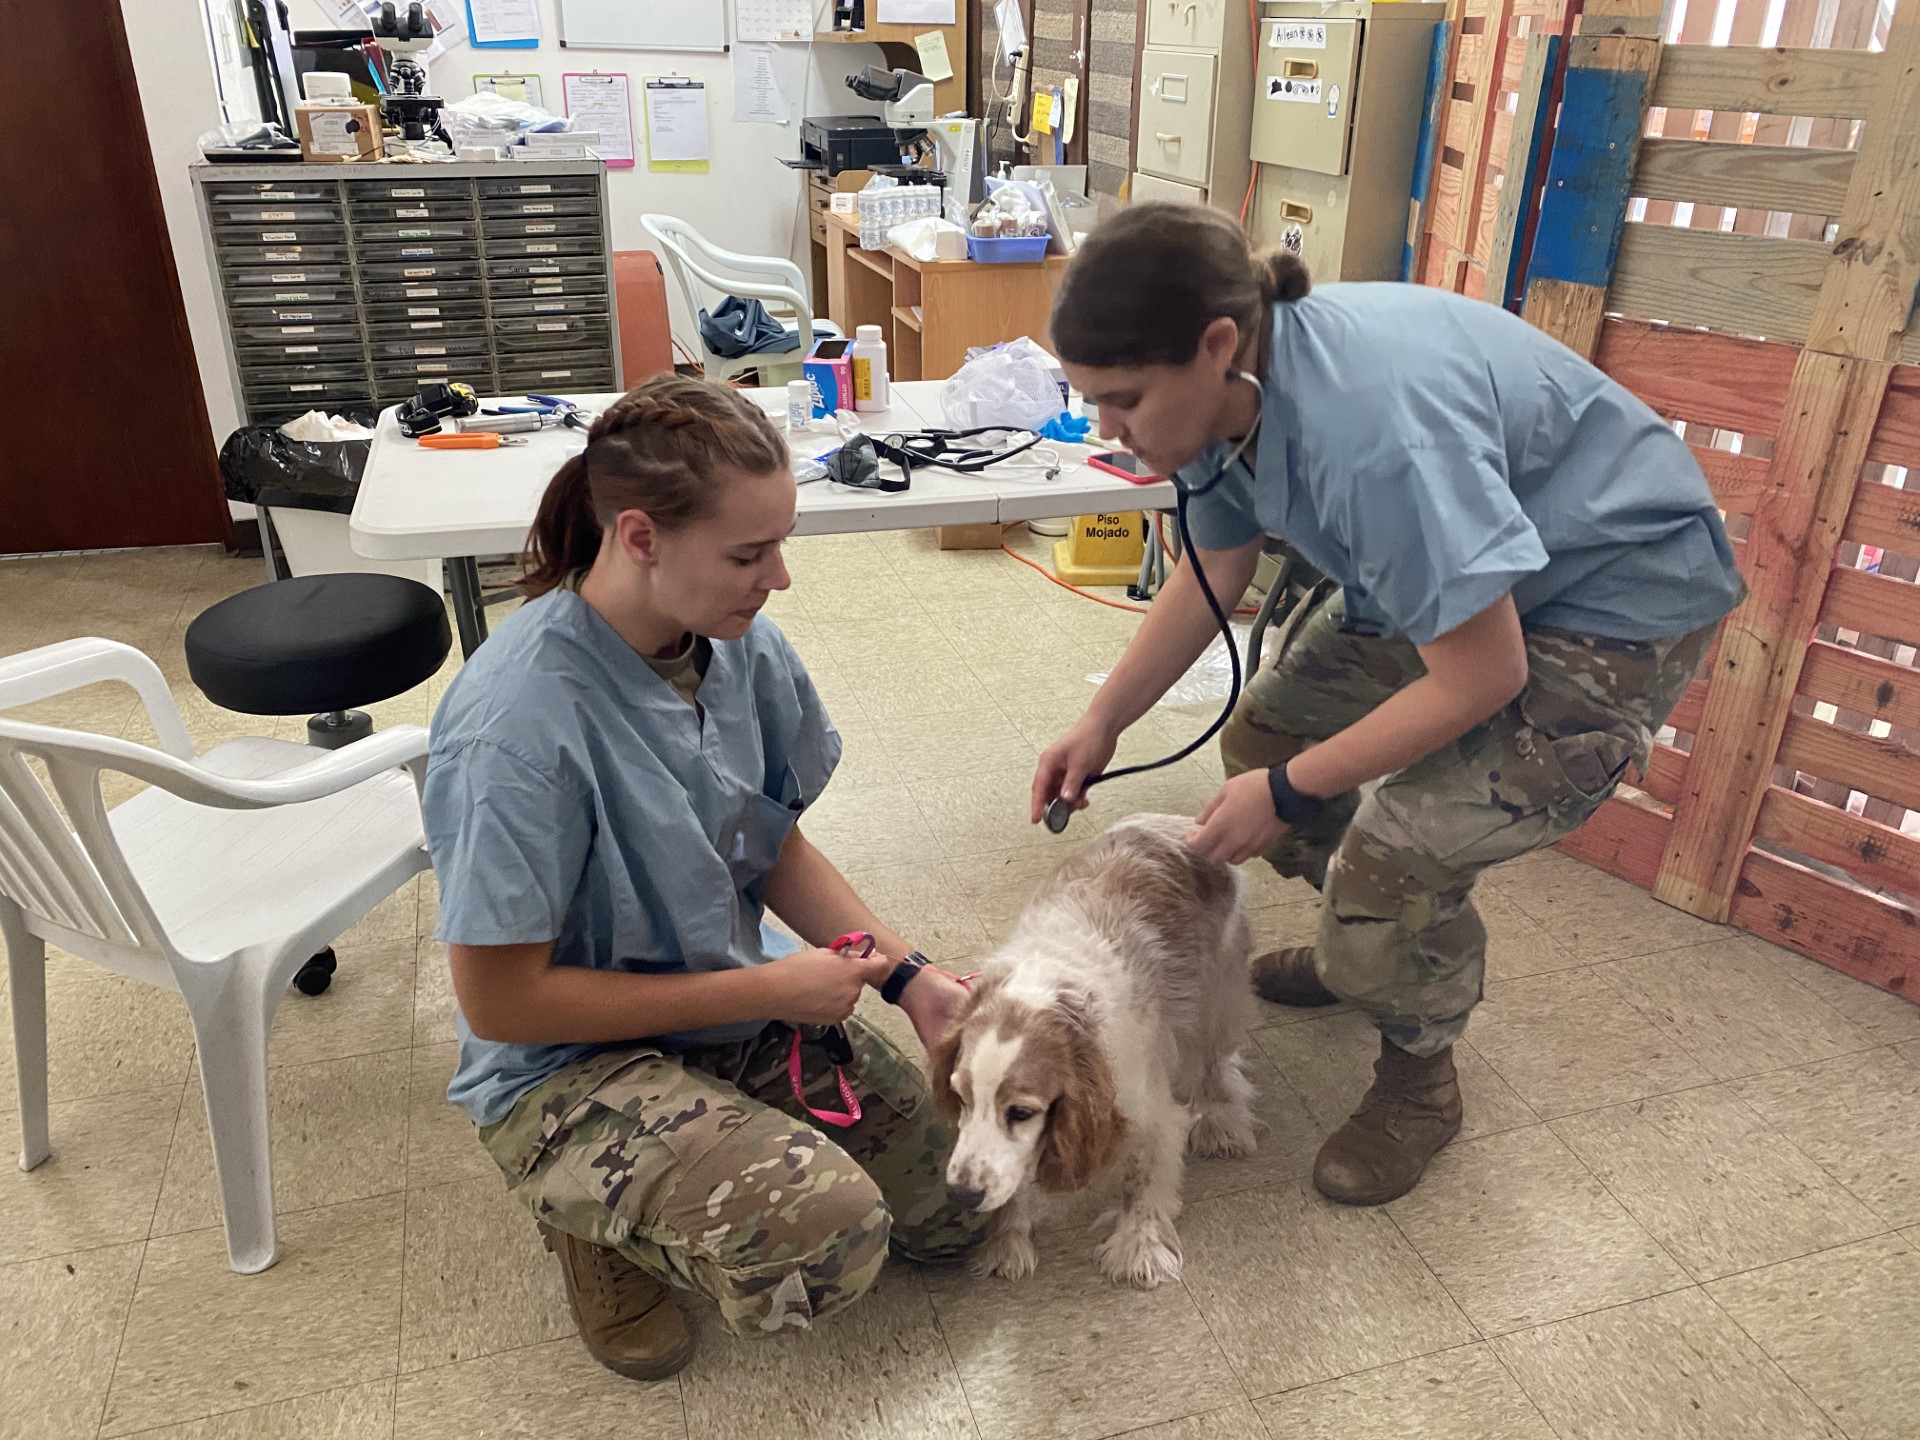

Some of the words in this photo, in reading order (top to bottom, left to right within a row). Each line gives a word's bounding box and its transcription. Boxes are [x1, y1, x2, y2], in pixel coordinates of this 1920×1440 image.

[1276, 27, 1299, 43] Aileen
[806, 373, 825, 409] Ziploc
[1097, 514, 1120, 525] Piso
[1086, 527, 1130, 541] Mojado
